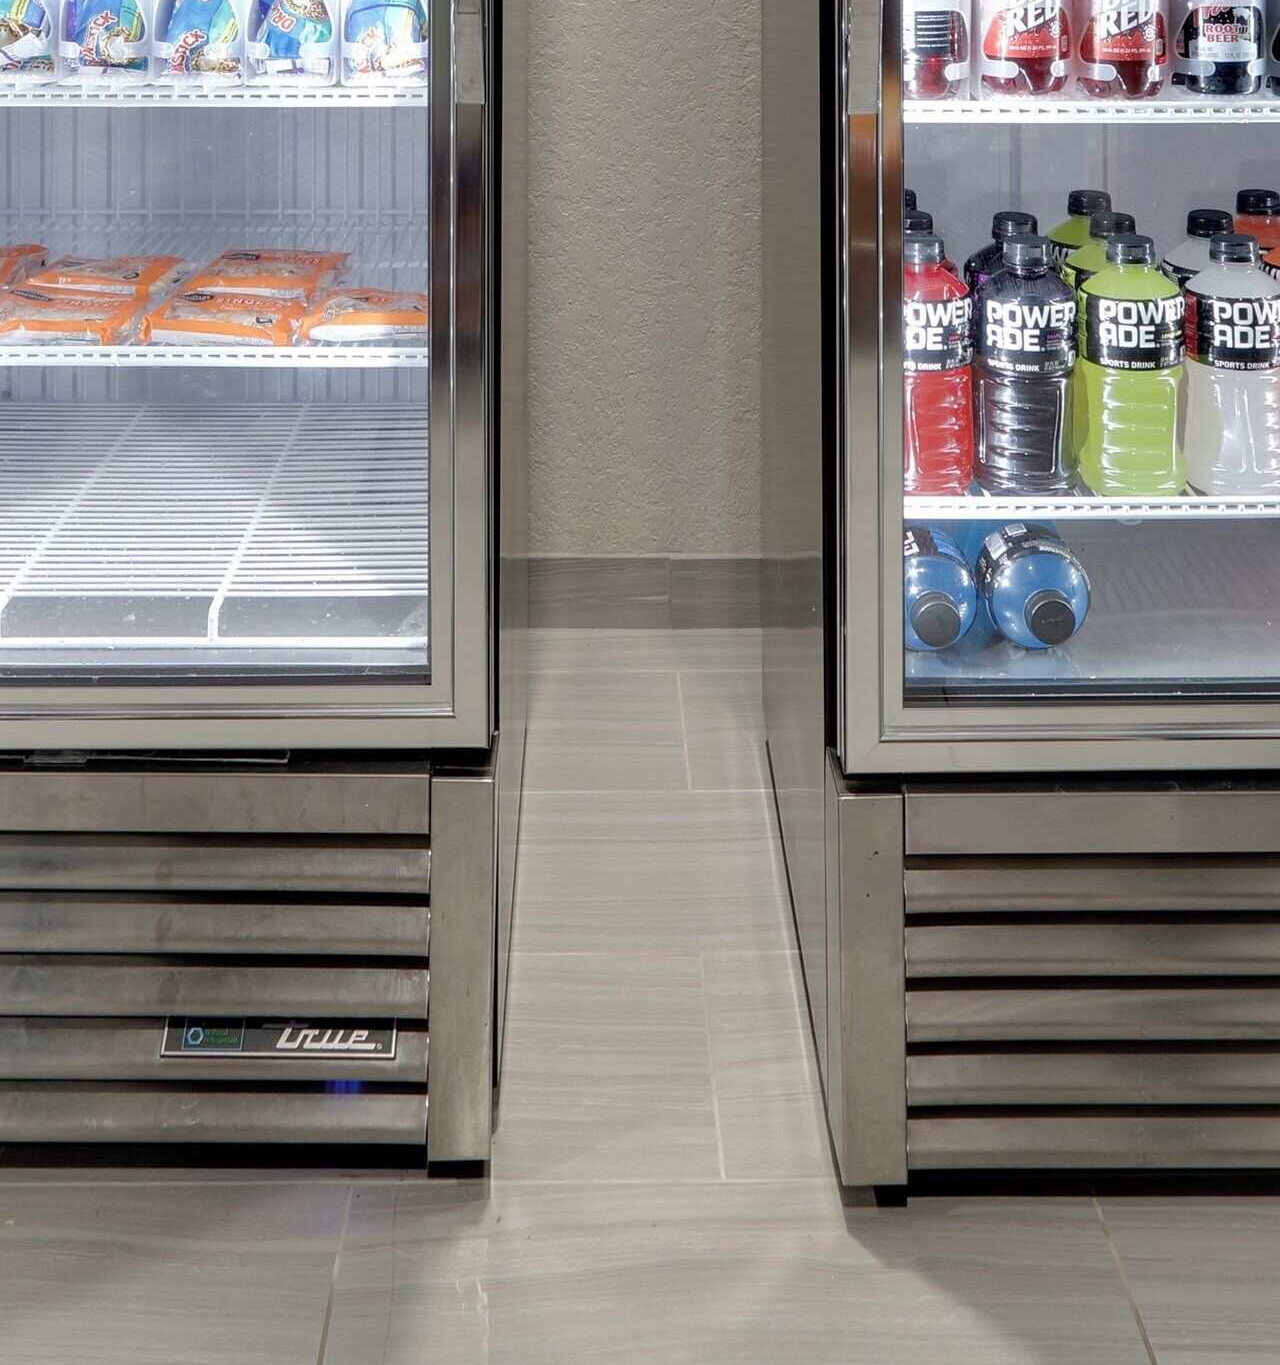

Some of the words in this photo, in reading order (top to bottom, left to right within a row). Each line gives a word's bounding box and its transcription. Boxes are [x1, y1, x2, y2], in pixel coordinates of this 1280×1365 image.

[1205, 23, 1239, 34] ROOT
[1207, 34, 1239, 43] BEER
[904, 298, 973, 327] OWER
[986, 300, 1076, 329] POWER
[1099, 297, 1186, 325] POWER
[905, 326, 944, 351] DE
[986, 324, 1041, 352] ADE
[1099, 323, 1156, 349] ADE
[1213, 324, 1272, 349] ADE
[917, 362, 942, 371] DRINK
[1015, 363, 1040, 371] DRINK
[1100, 357, 1130, 368] SPORTS
[1131, 360, 1156, 369] DRINK
[1214, 360, 1246, 369] SPORTS
[1247, 361, 1270, 369] DRINK
